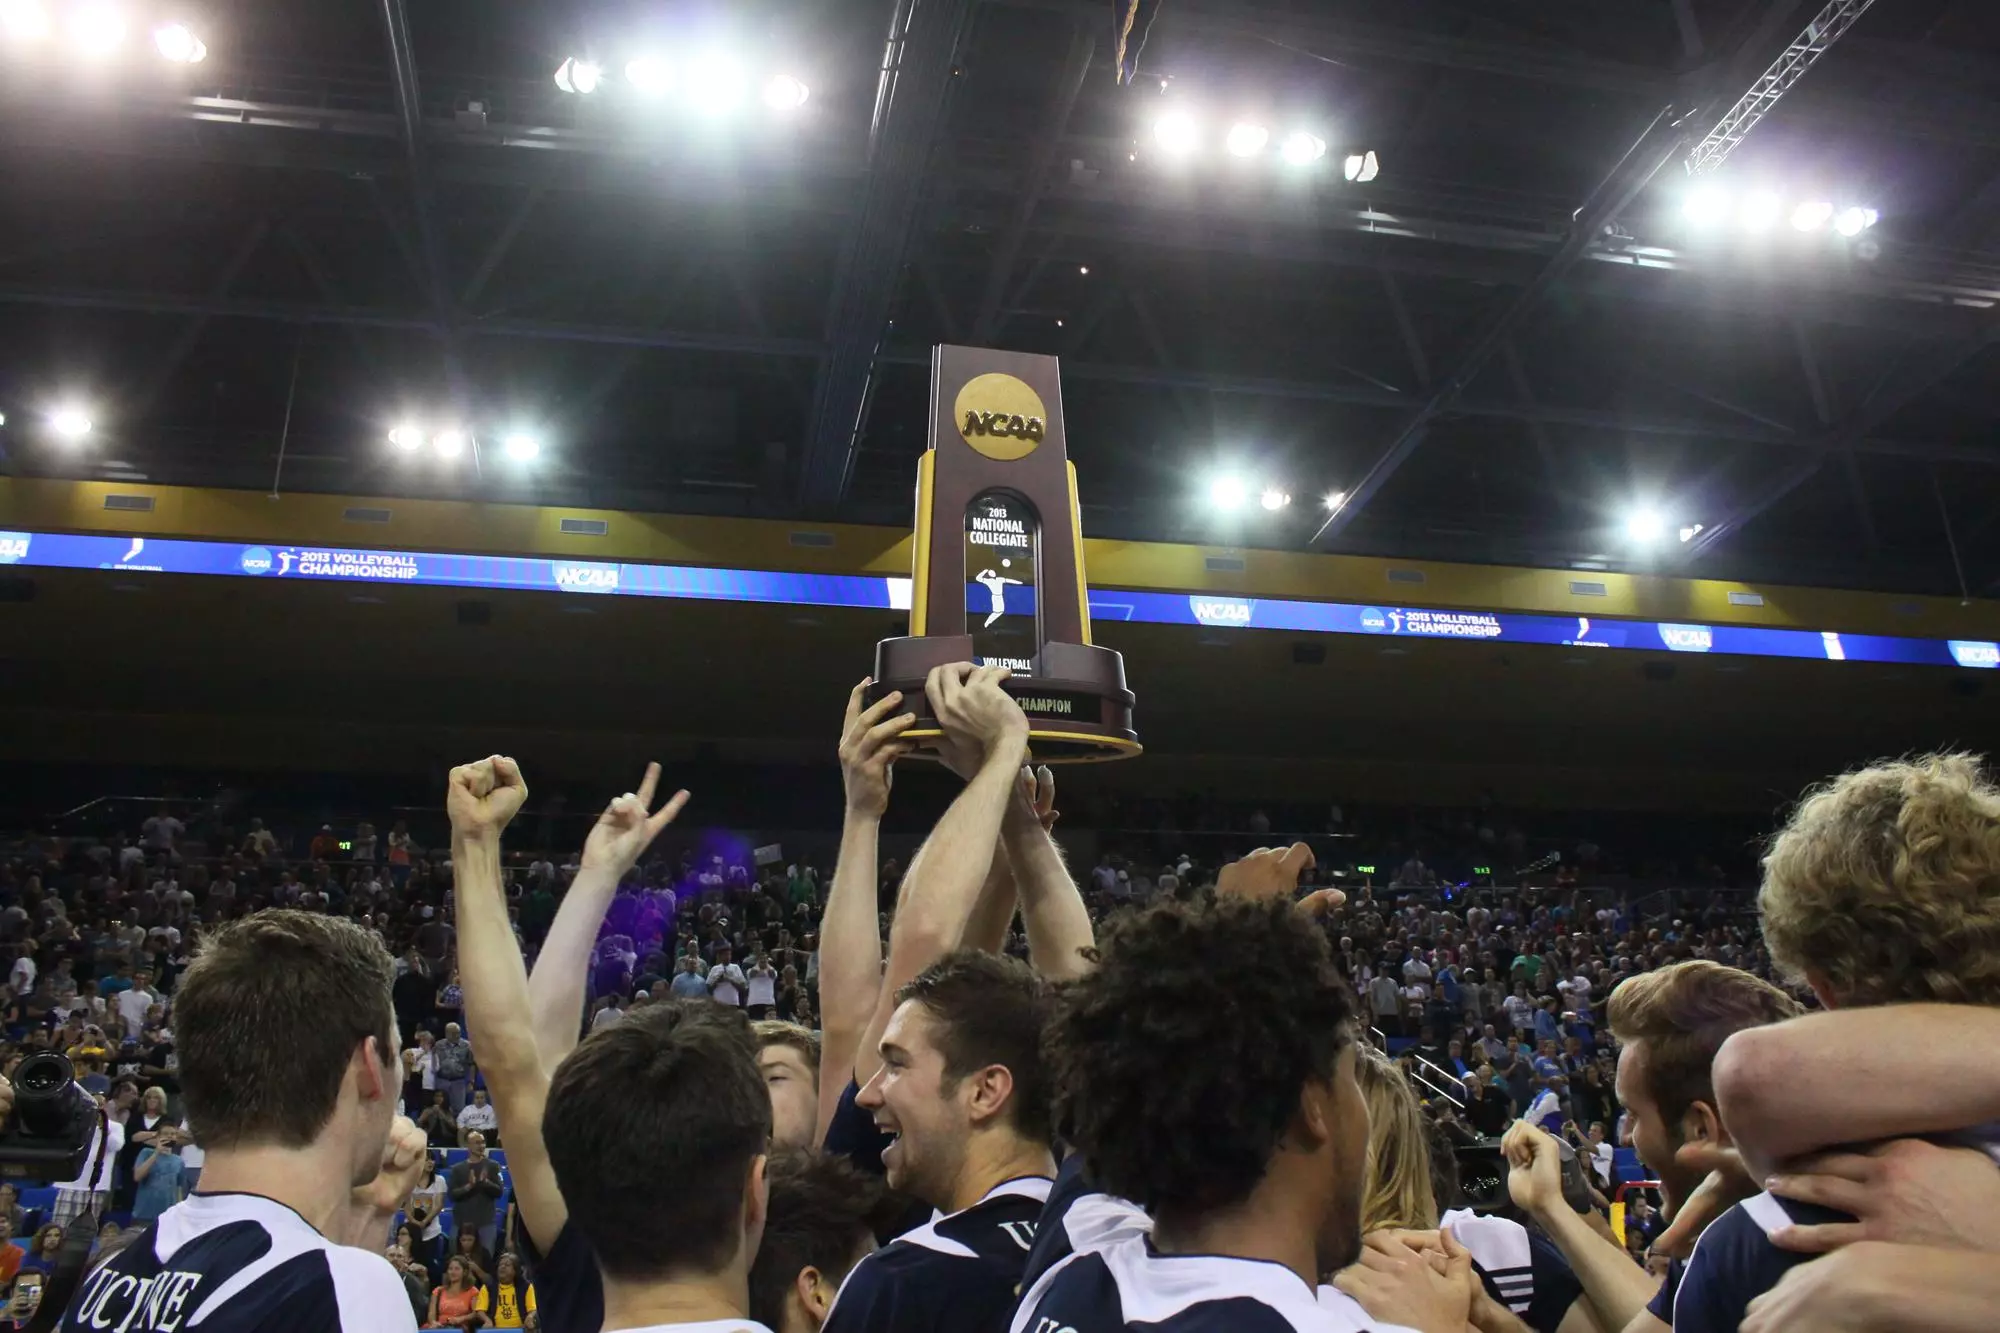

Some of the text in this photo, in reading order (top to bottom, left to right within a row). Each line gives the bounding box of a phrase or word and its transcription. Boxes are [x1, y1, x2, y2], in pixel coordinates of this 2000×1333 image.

[962, 409, 1045, 443] NCAA
[989, 507, 1007, 519] 2013
[972, 517, 1025, 534] NATIONAL
[969, 531, 1028, 548] COLLEGIATE
[300, 551, 418, 567] 2013 VOLLEYBALL
[298, 562, 419, 580] CHAMPIONSHIP
[556, 567, 619, 588] NCAA
[1196, 602, 1250, 621] NCAA
[1406, 612, 1499, 626] 2013 VOLLEYBALL
[1407, 622, 1501, 637] CHAMPIONSHIP
[1665, 628, 1712, 648] NCAA
[983, 656, 1032, 670] VOLLEYBALL
[1956, 646, 2000, 663] NCAA
[1016, 696, 1072, 713] CHAMPION
